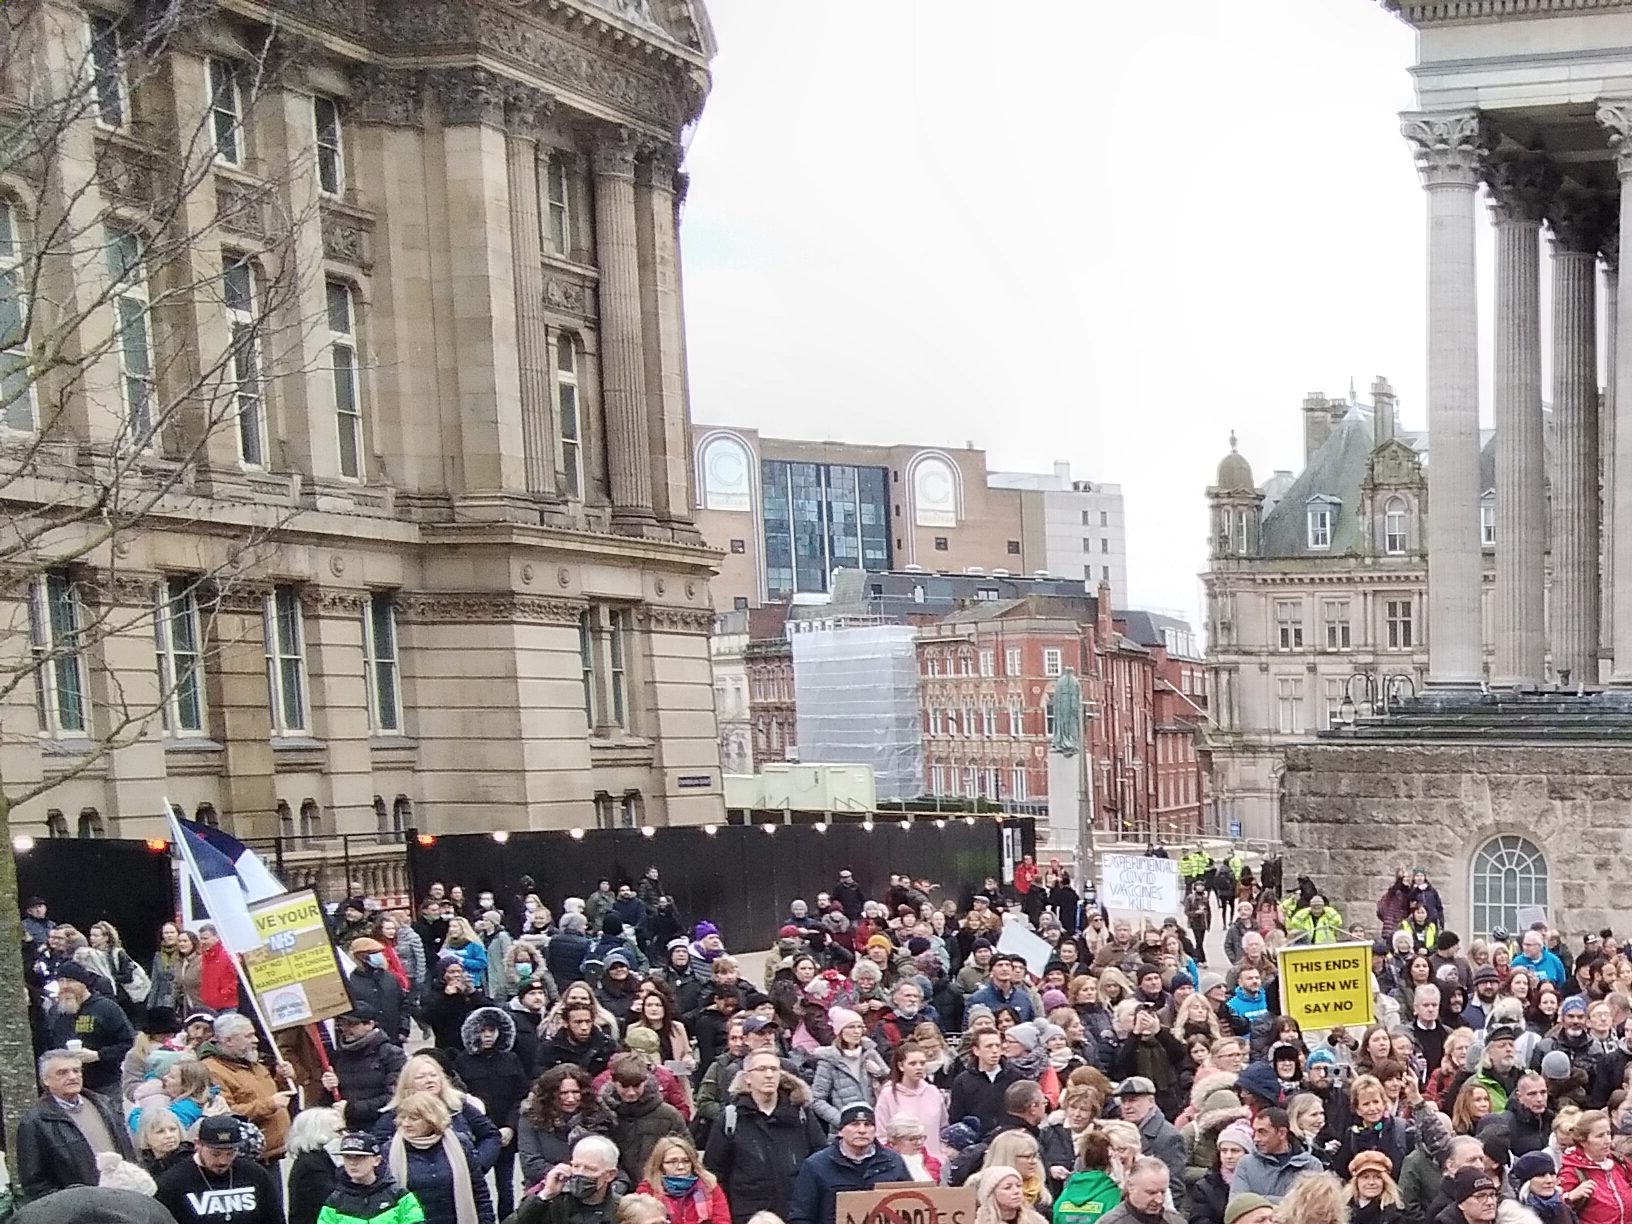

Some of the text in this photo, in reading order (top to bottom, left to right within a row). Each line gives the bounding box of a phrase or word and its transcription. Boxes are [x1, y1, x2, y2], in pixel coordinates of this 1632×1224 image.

[1103, 854, 1177, 873] EXPERIMENTAL
[1119, 870, 1156, 885] COVID
[1110, 883, 1163, 900] VACCINES
[278, 905, 319, 926] YOUR
[270, 931, 296, 952] NHS
[1291, 958, 1360, 973] THIS ENDS
[1295, 979, 1359, 994] WHEN WE
[1304, 1000, 1354, 1014] SAY NO
[186, 1186, 257, 1216] VANS
